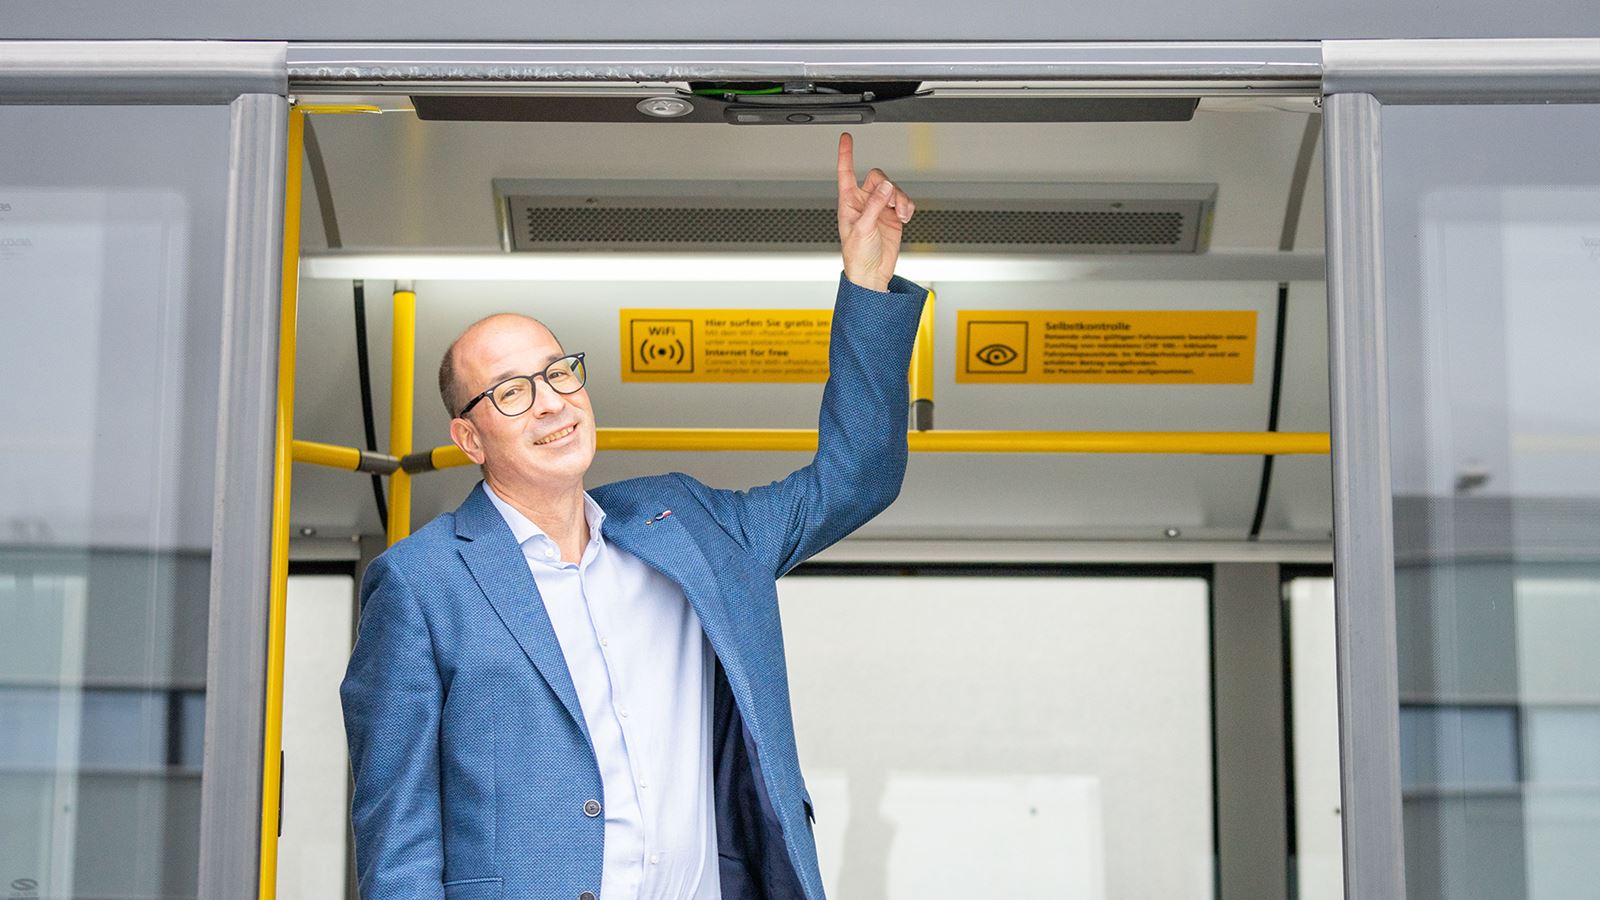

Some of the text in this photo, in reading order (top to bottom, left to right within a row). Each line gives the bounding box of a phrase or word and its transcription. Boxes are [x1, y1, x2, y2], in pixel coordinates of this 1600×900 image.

[705, 319, 727, 328] Hier
[730, 319, 764, 328] surfen
[766, 319, 782, 328] Sie
[784, 319, 814, 329] gratis
[1045, 322, 1131, 331] Selbstkontrolle
[648, 326, 676, 336] WiFi
[705, 349, 789, 357] Internet for free
